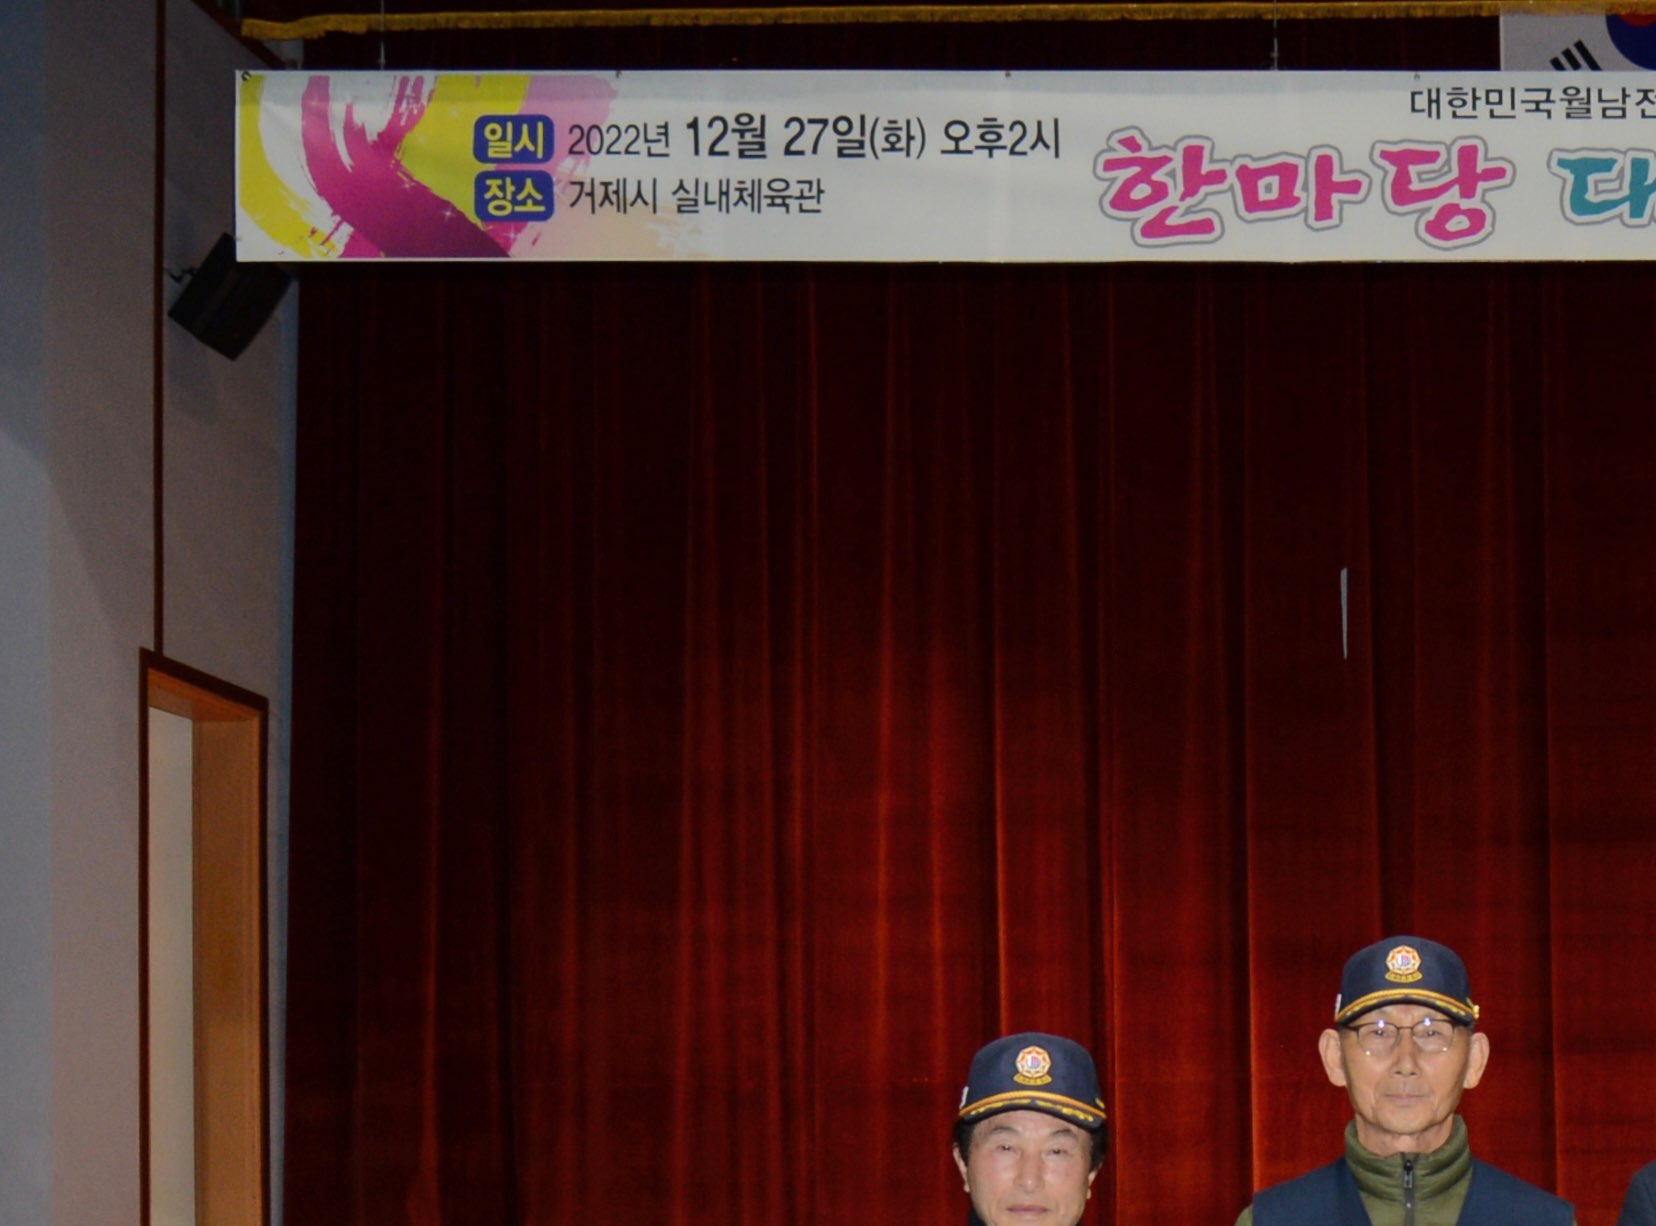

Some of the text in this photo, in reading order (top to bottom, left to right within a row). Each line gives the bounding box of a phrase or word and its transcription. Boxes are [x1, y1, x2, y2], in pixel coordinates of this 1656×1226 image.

[484, 112, 1060, 160] 일시 2022년 12월 27일(화) 오후2시
[484, 177, 825, 217] 장소 거제시 실내체육관
[1099, 132, 1508, 242] 한마당
